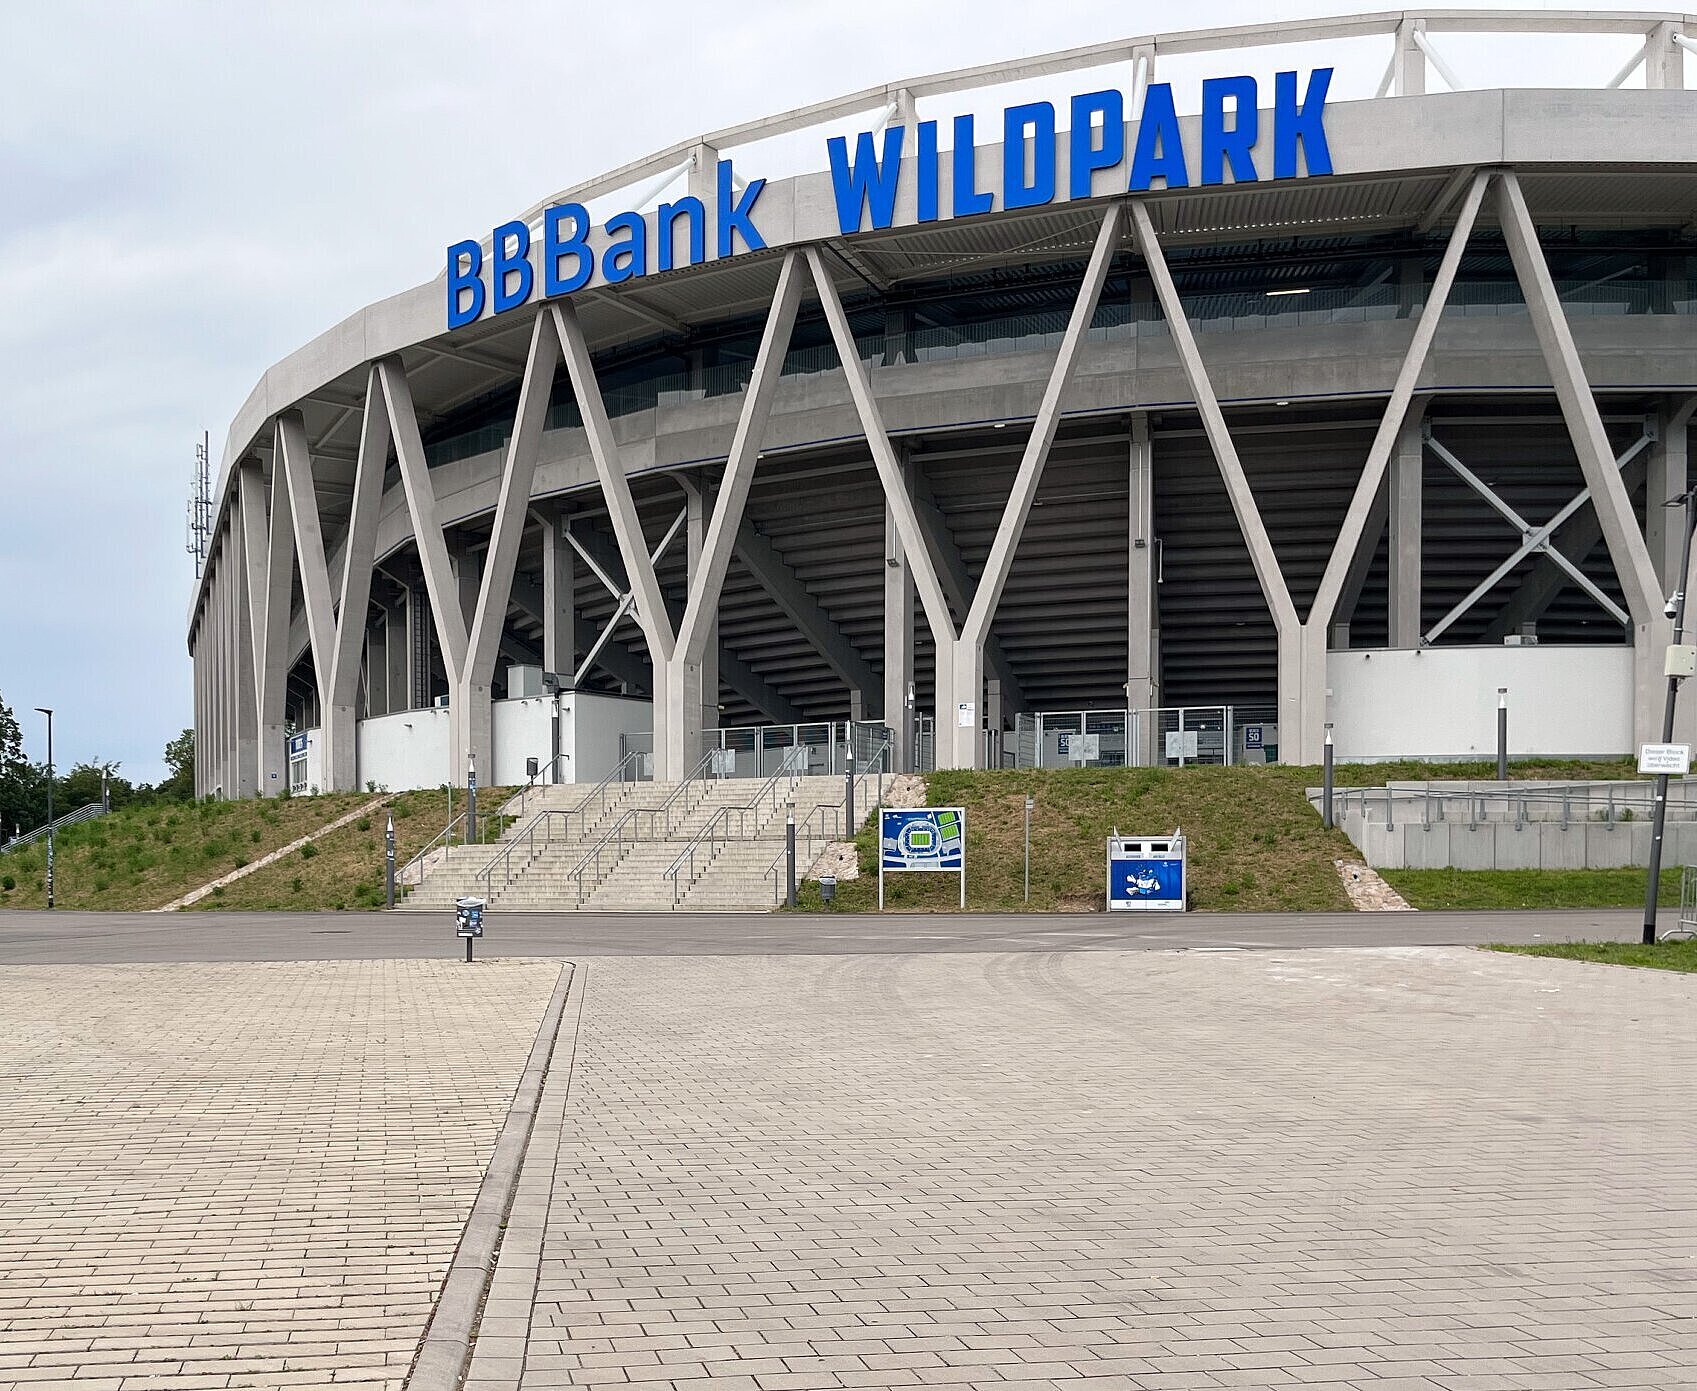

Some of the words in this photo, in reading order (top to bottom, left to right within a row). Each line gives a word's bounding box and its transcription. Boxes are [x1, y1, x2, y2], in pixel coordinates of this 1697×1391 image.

[447, 161, 766, 329] BBBank
[828, 68, 1333, 233] WILDPARK
[1249, 732, 1260, 742] 50
